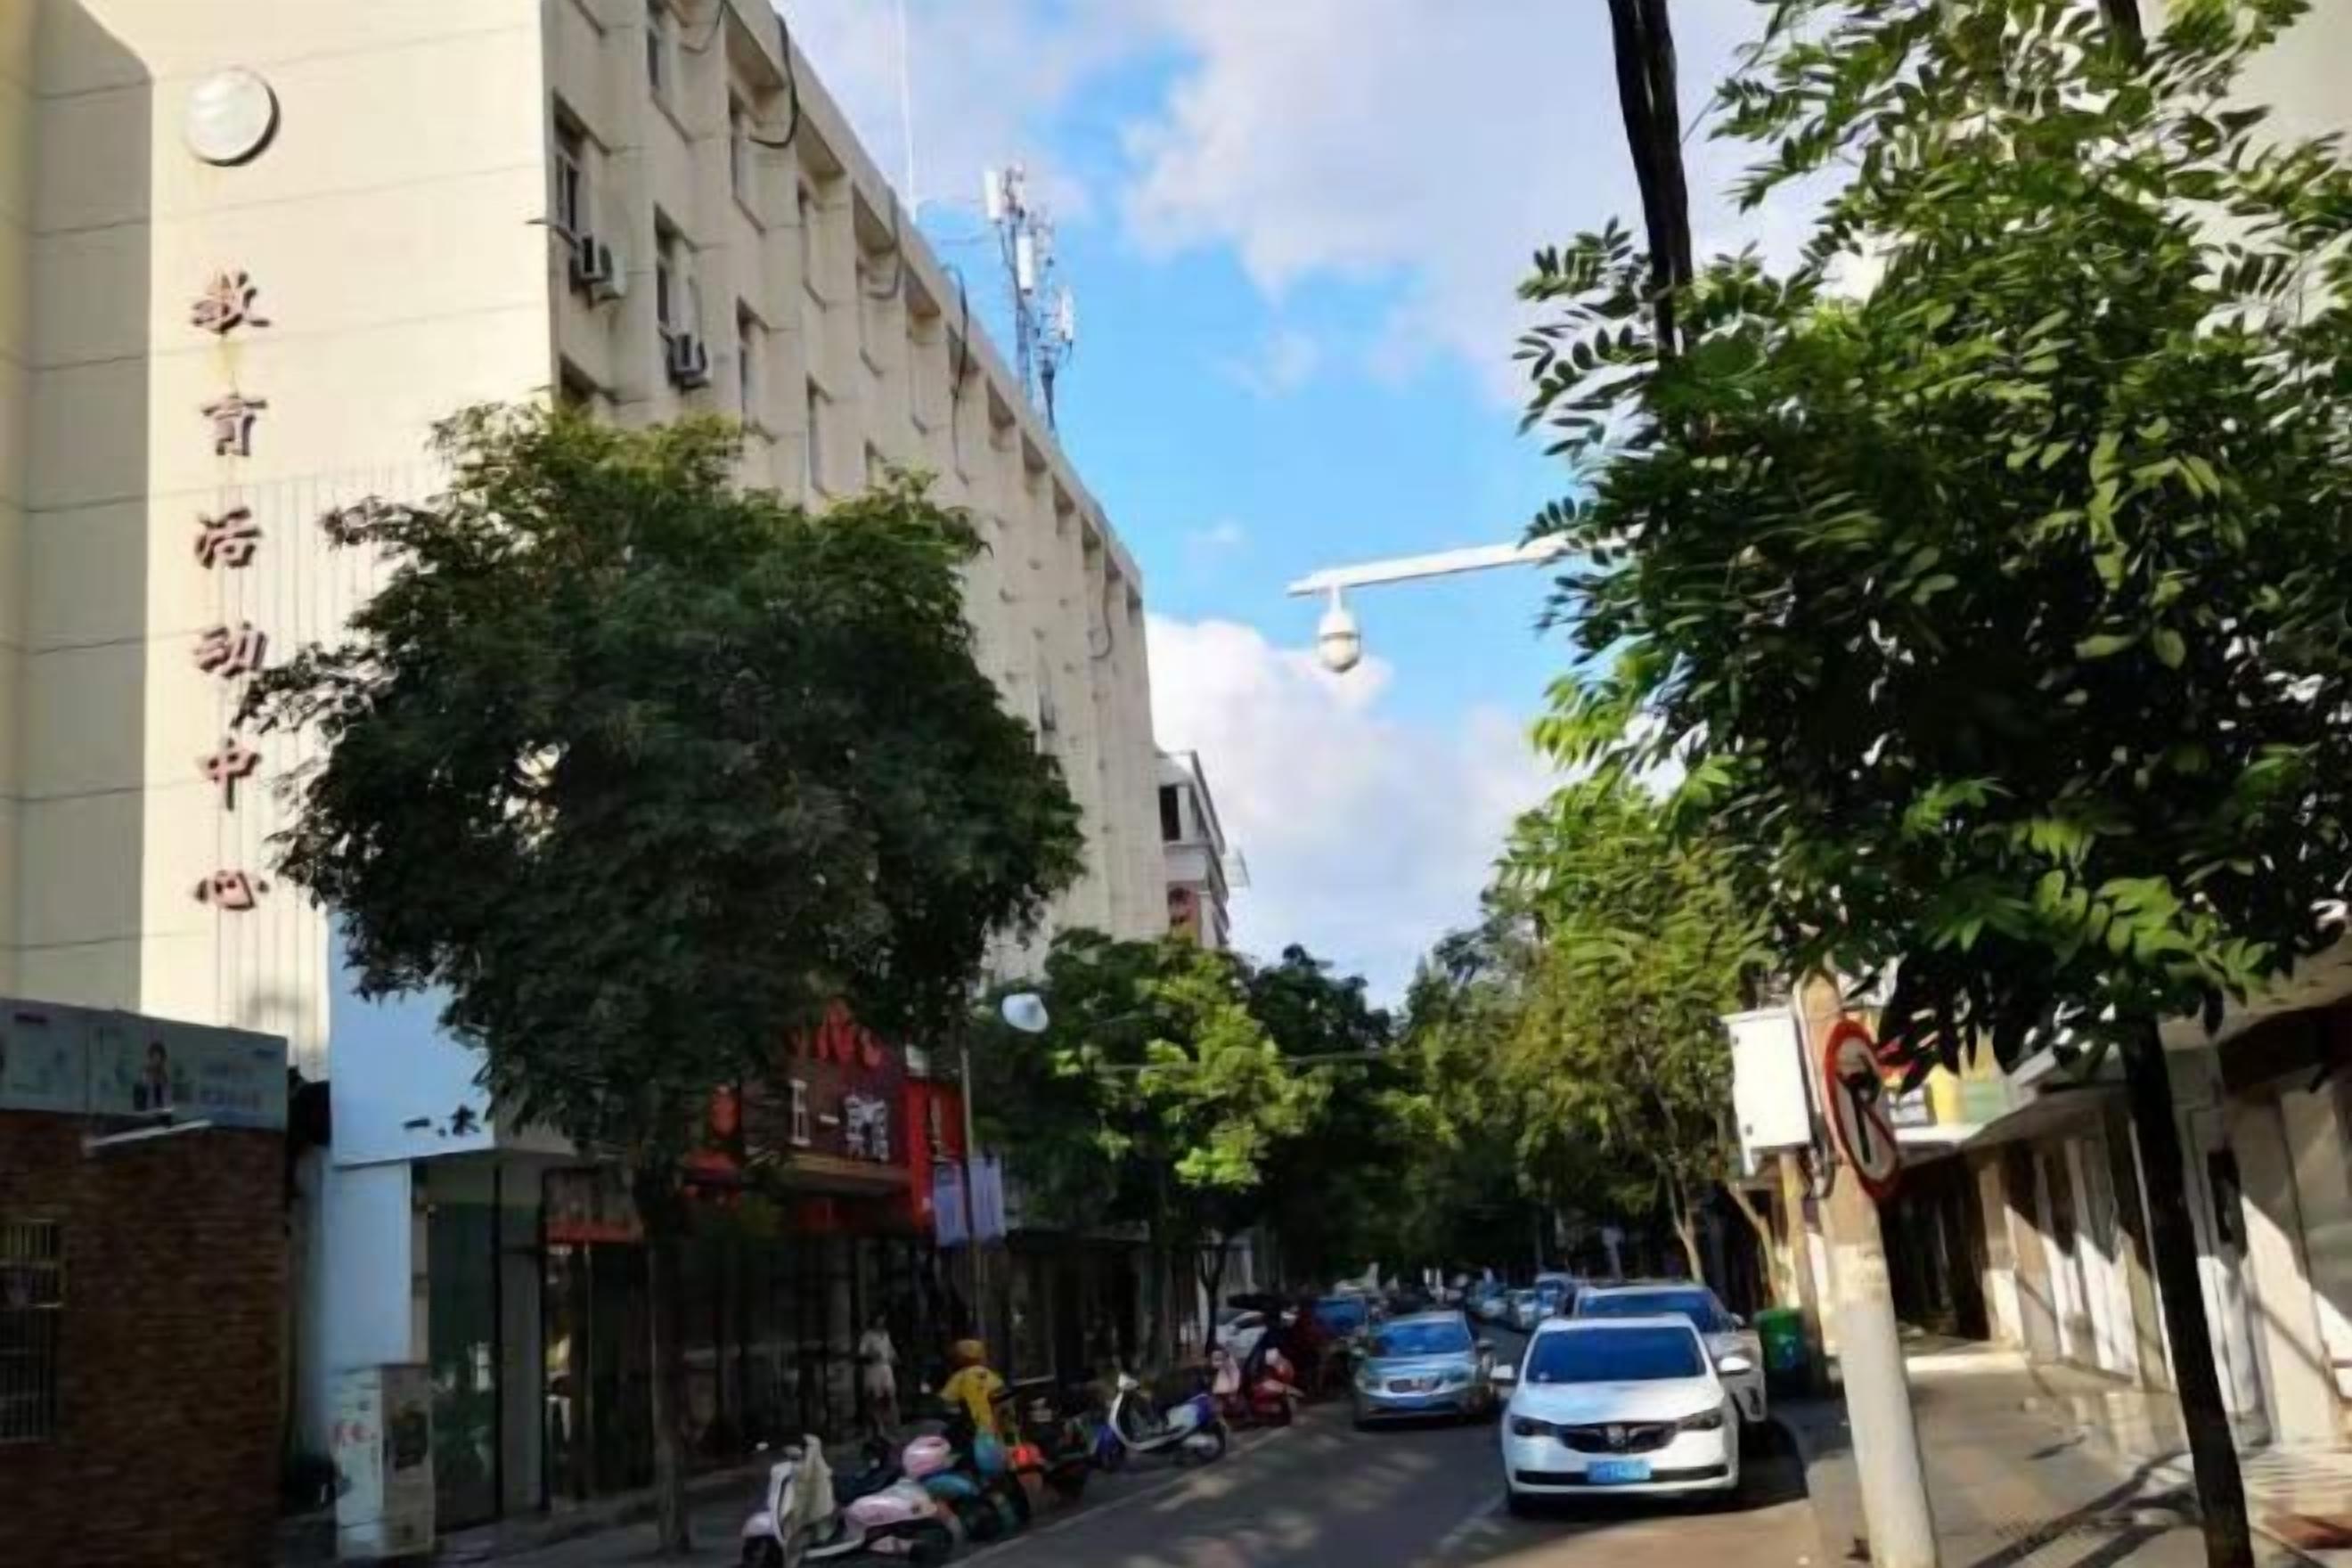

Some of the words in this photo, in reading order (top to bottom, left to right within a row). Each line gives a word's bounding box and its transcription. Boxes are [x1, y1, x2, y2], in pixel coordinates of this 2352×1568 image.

[190, 269, 271, 912] 教育活动中心
